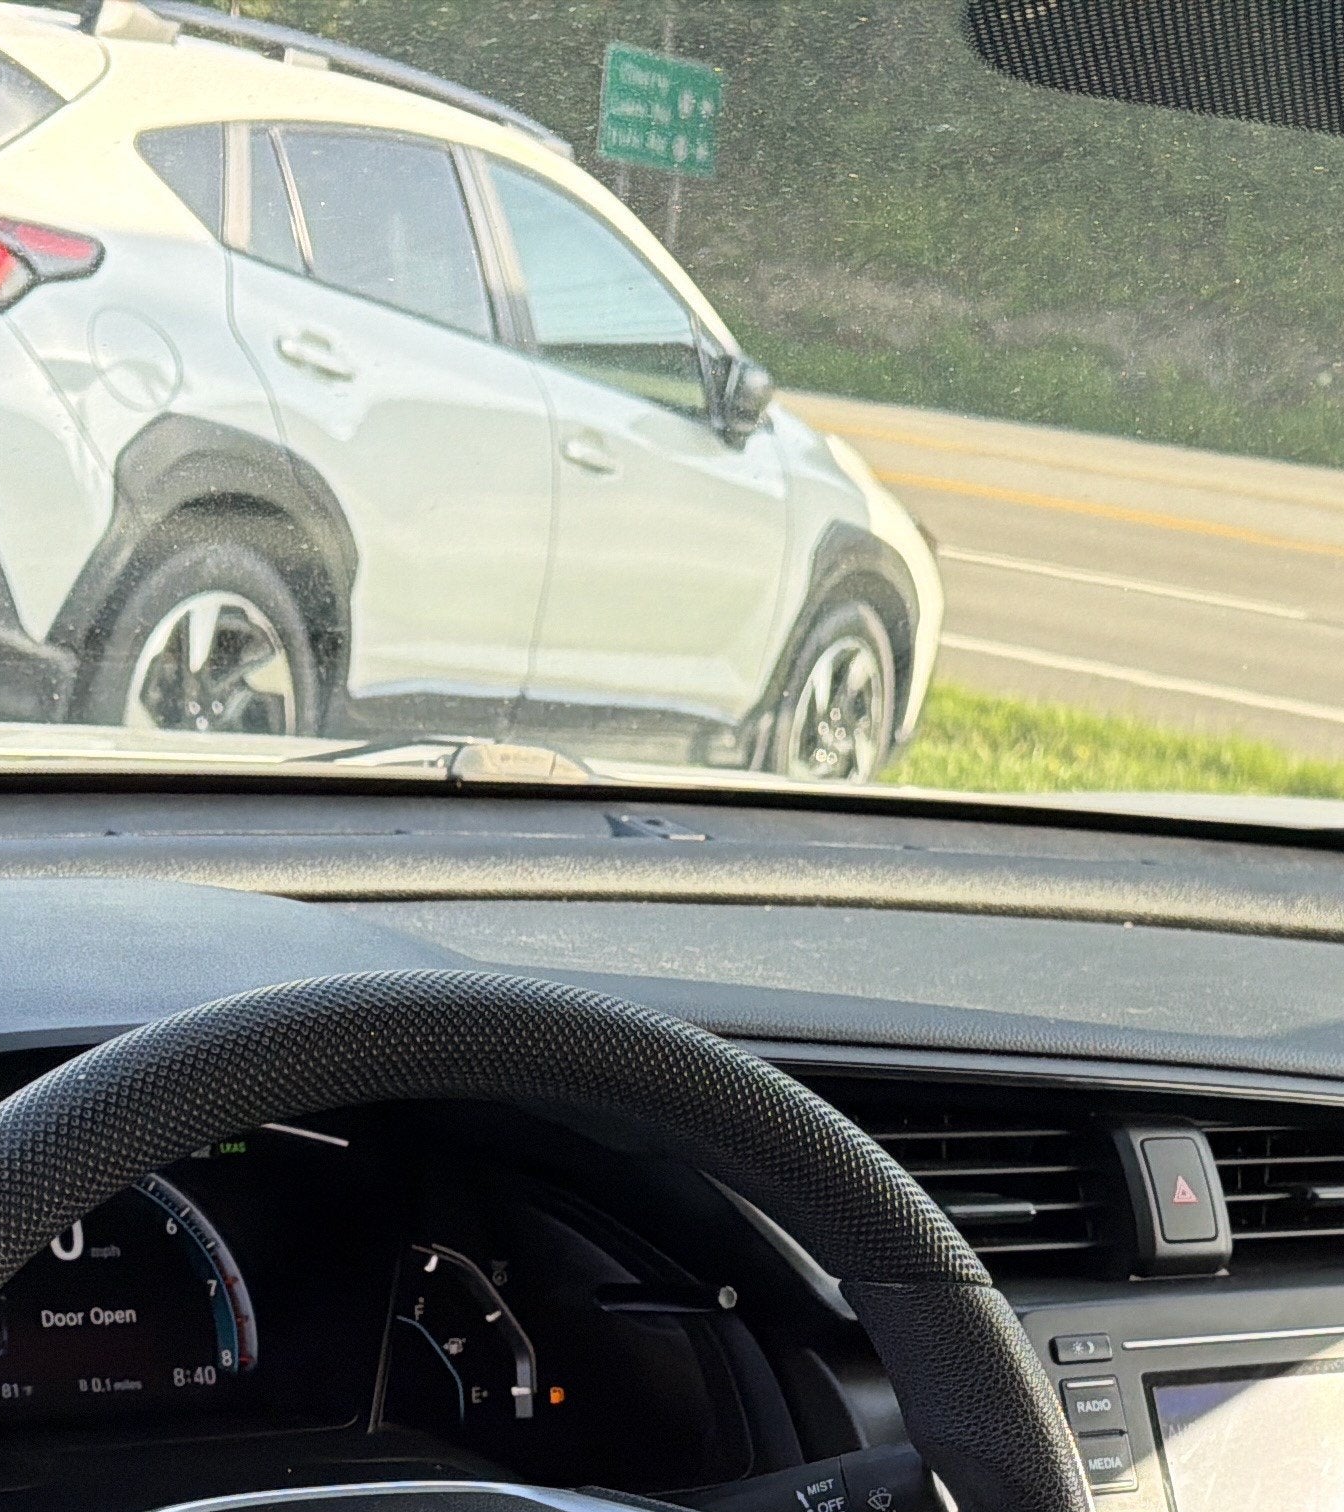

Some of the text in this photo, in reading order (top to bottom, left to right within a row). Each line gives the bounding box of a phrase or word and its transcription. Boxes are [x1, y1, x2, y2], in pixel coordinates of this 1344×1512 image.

[166, 1218, 177, 1235] 6
[207, 1279, 217, 1297] 7
[41, 1307, 137, 1328] Door Open
[221, 1349, 232, 1367] 8
[173, 1366, 216, 1387] 8:40
[1076, 1398, 1112, 1414] RADIO
[1088, 1456, 1124, 1471] MEDIA
[806, 1478, 835, 1496] MIST
